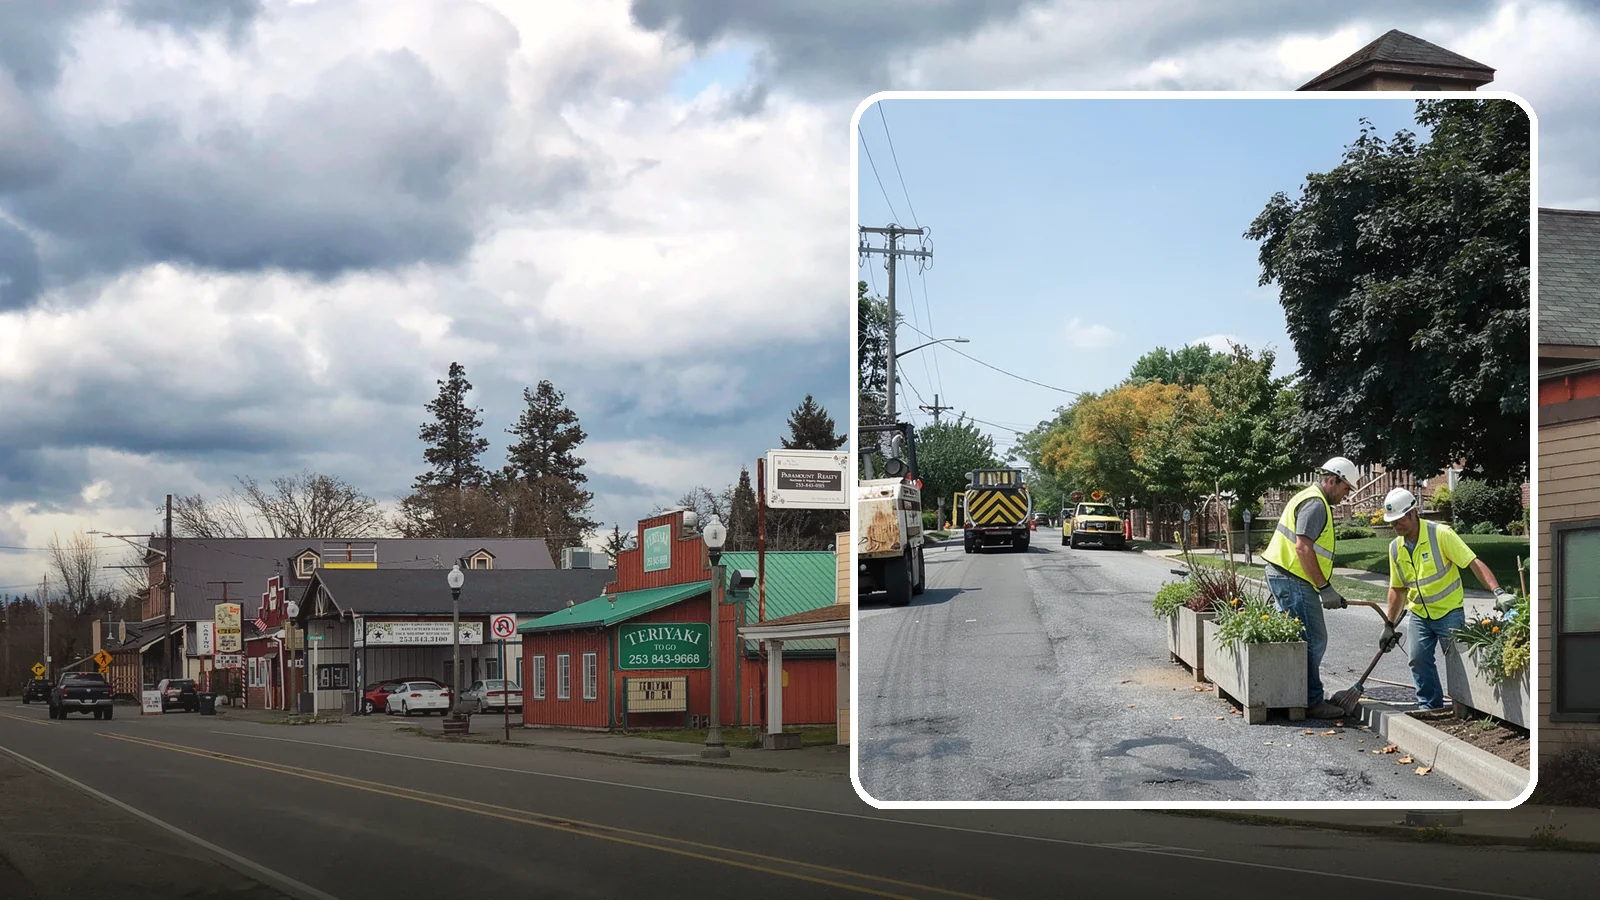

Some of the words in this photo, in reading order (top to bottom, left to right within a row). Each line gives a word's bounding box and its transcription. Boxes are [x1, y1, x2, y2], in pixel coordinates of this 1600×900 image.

[781, 471, 814, 479] PARAMOUNT
[817, 472, 839, 480] REALTY
[624, 628, 702, 646] TERIYAKI
[629, 654, 649, 664] 253
[651, 654, 700, 664] 843-9668
[639, 681, 672, 690] TERIYAKI
[662, 690, 672, 700] GO
